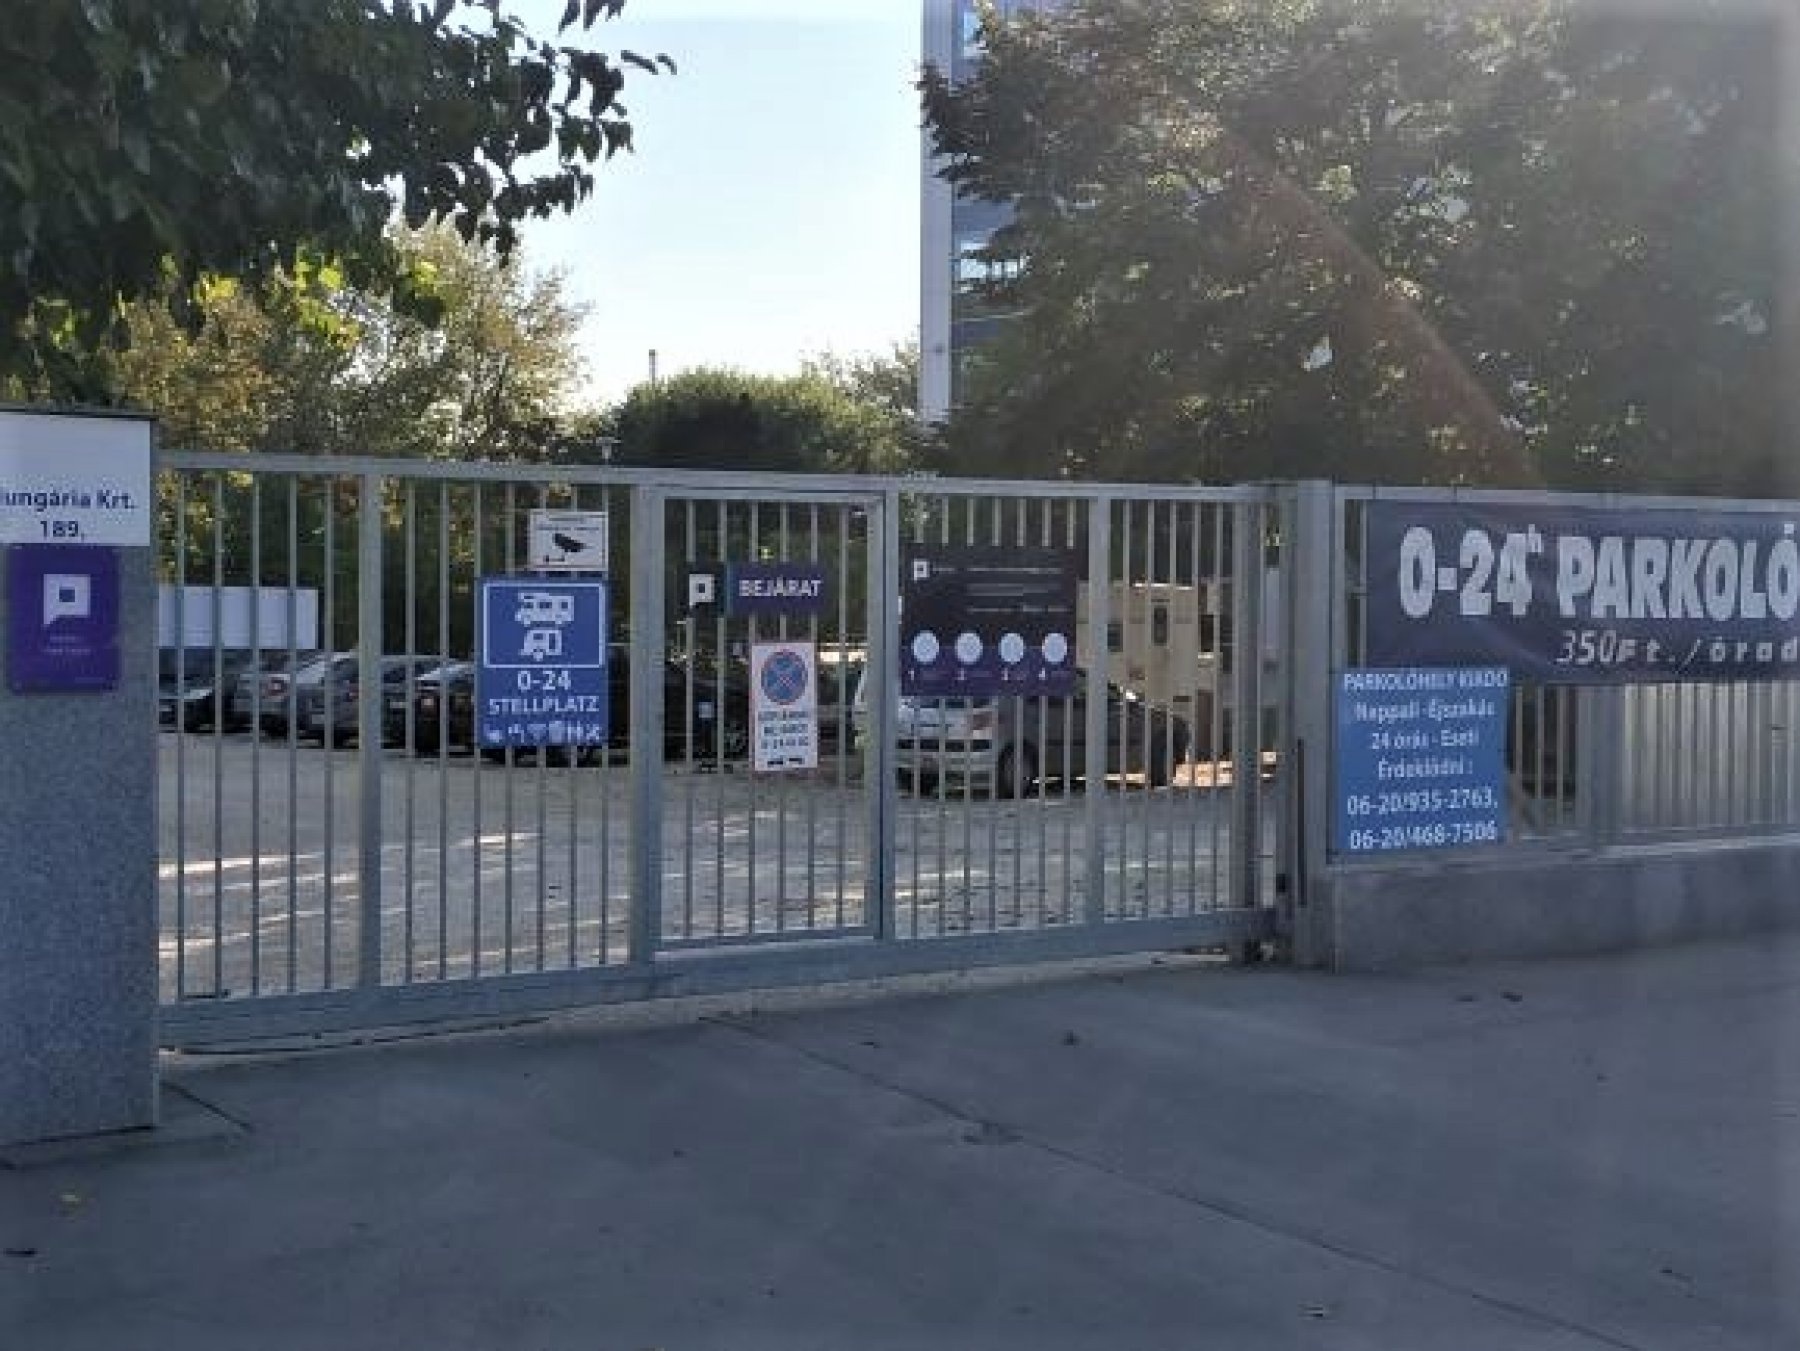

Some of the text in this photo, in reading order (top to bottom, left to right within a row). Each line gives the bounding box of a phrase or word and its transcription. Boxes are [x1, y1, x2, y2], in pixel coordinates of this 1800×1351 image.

[0, 485, 91, 512] ungária
[1556, 522, 1799, 621] PARKOLÓ
[517, 670, 572, 691] 0-24
[489, 696, 600, 716] STELLPLATZ
